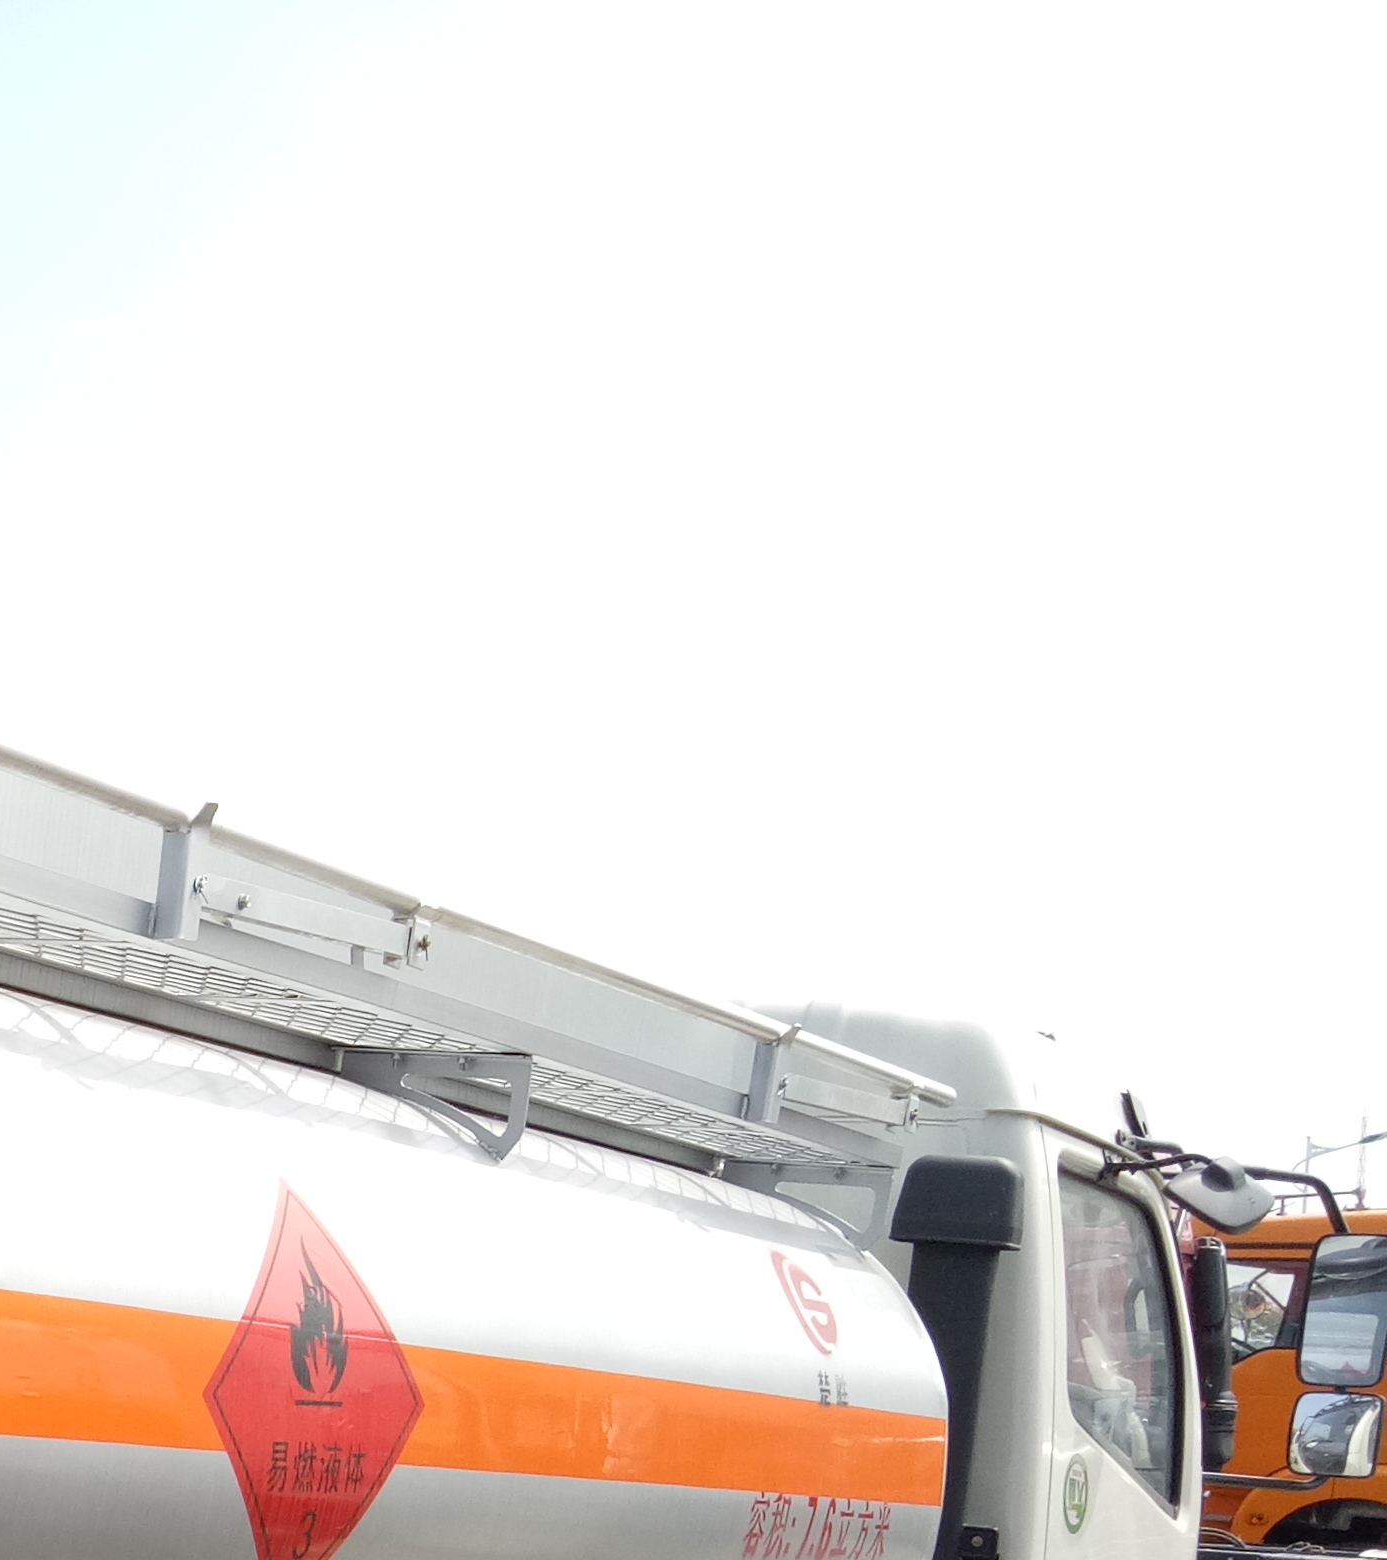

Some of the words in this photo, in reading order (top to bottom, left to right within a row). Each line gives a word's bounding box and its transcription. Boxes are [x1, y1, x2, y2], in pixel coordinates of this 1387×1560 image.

[266, 1441, 367, 1494] 易燃液体
[292, 1510, 317, 1560] 3
